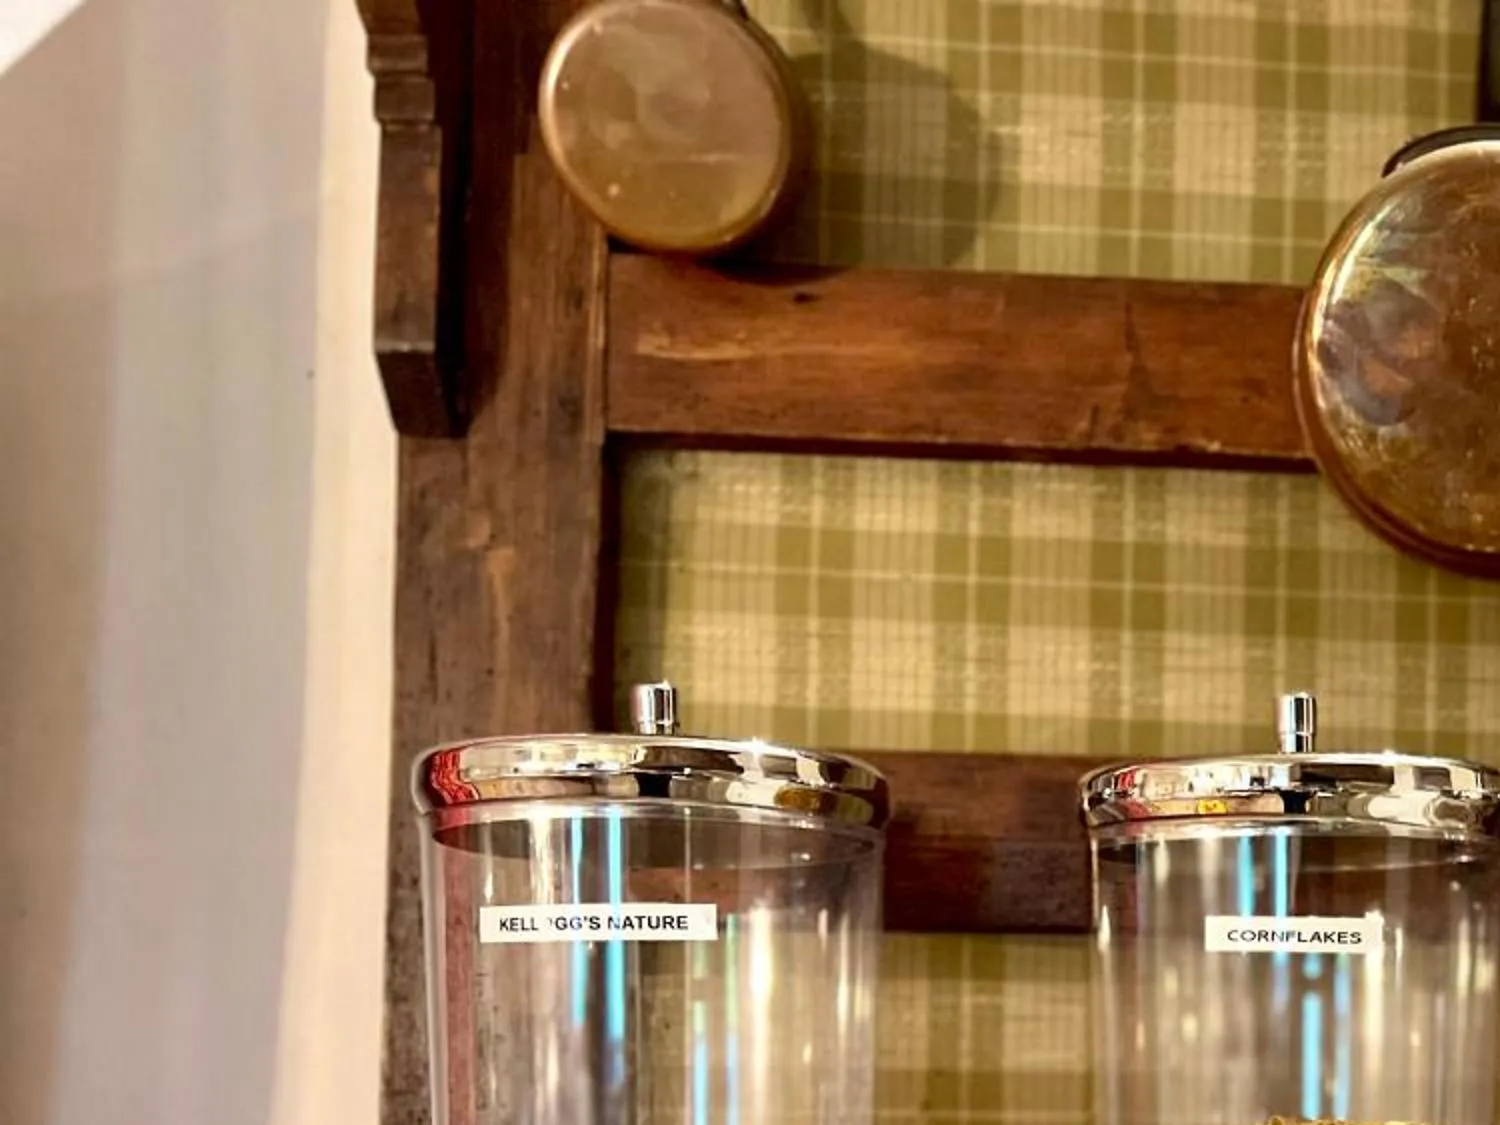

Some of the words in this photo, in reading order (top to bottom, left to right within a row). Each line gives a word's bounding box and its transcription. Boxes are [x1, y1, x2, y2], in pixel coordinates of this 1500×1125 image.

[499, 916, 600, 932] KELLGG'S
[607, 914, 689, 931] NATURE
[1227, 929, 1362, 945] CORNFLAKES
